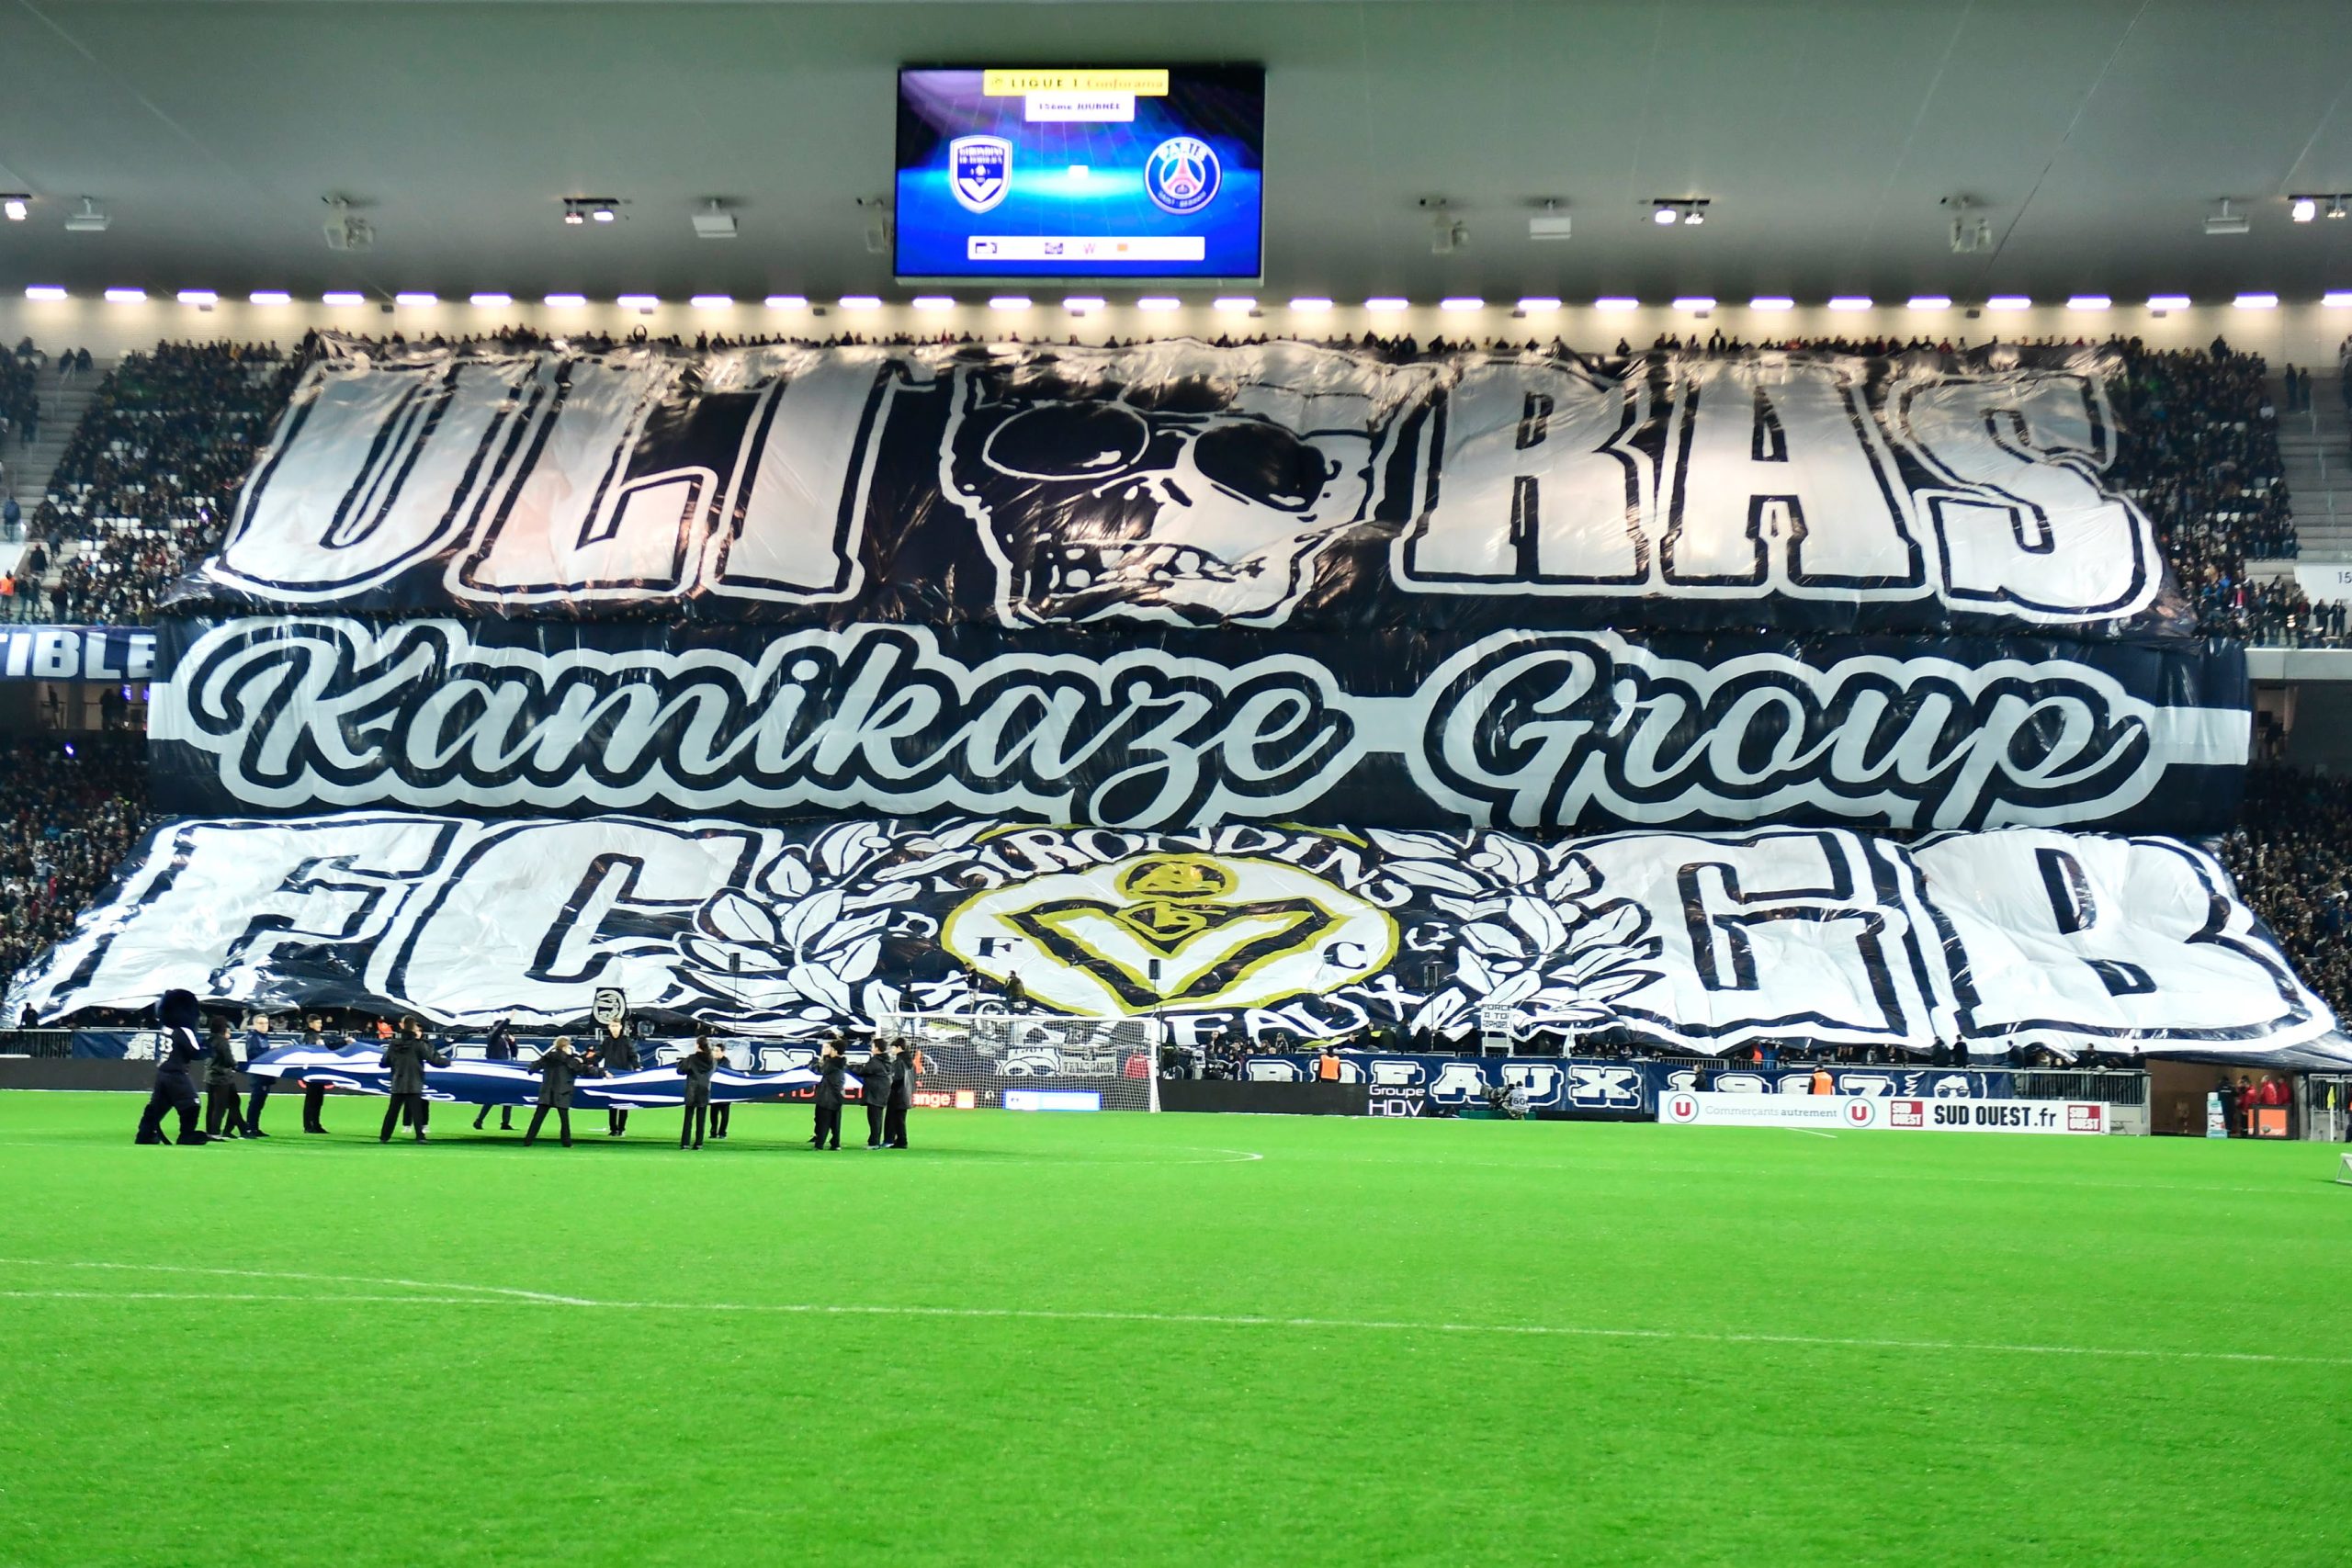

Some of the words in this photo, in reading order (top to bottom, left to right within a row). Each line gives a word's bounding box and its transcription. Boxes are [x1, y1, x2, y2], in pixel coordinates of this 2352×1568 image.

[189, 625, 1356, 831] Kamikaze
[1424, 632, 2154, 829] Group
[1368, 1083, 1426, 1097] Groupe
[1367, 1099, 1425, 1117] HDV
[1675, 1100, 1692, 1117] U
[1705, 1104, 1781, 1119] Commerçants
[1781, 1108, 1838, 1119] autrement
[1851, 1105, 1868, 1122] U
[1933, 1104, 1970, 1126] SUD
